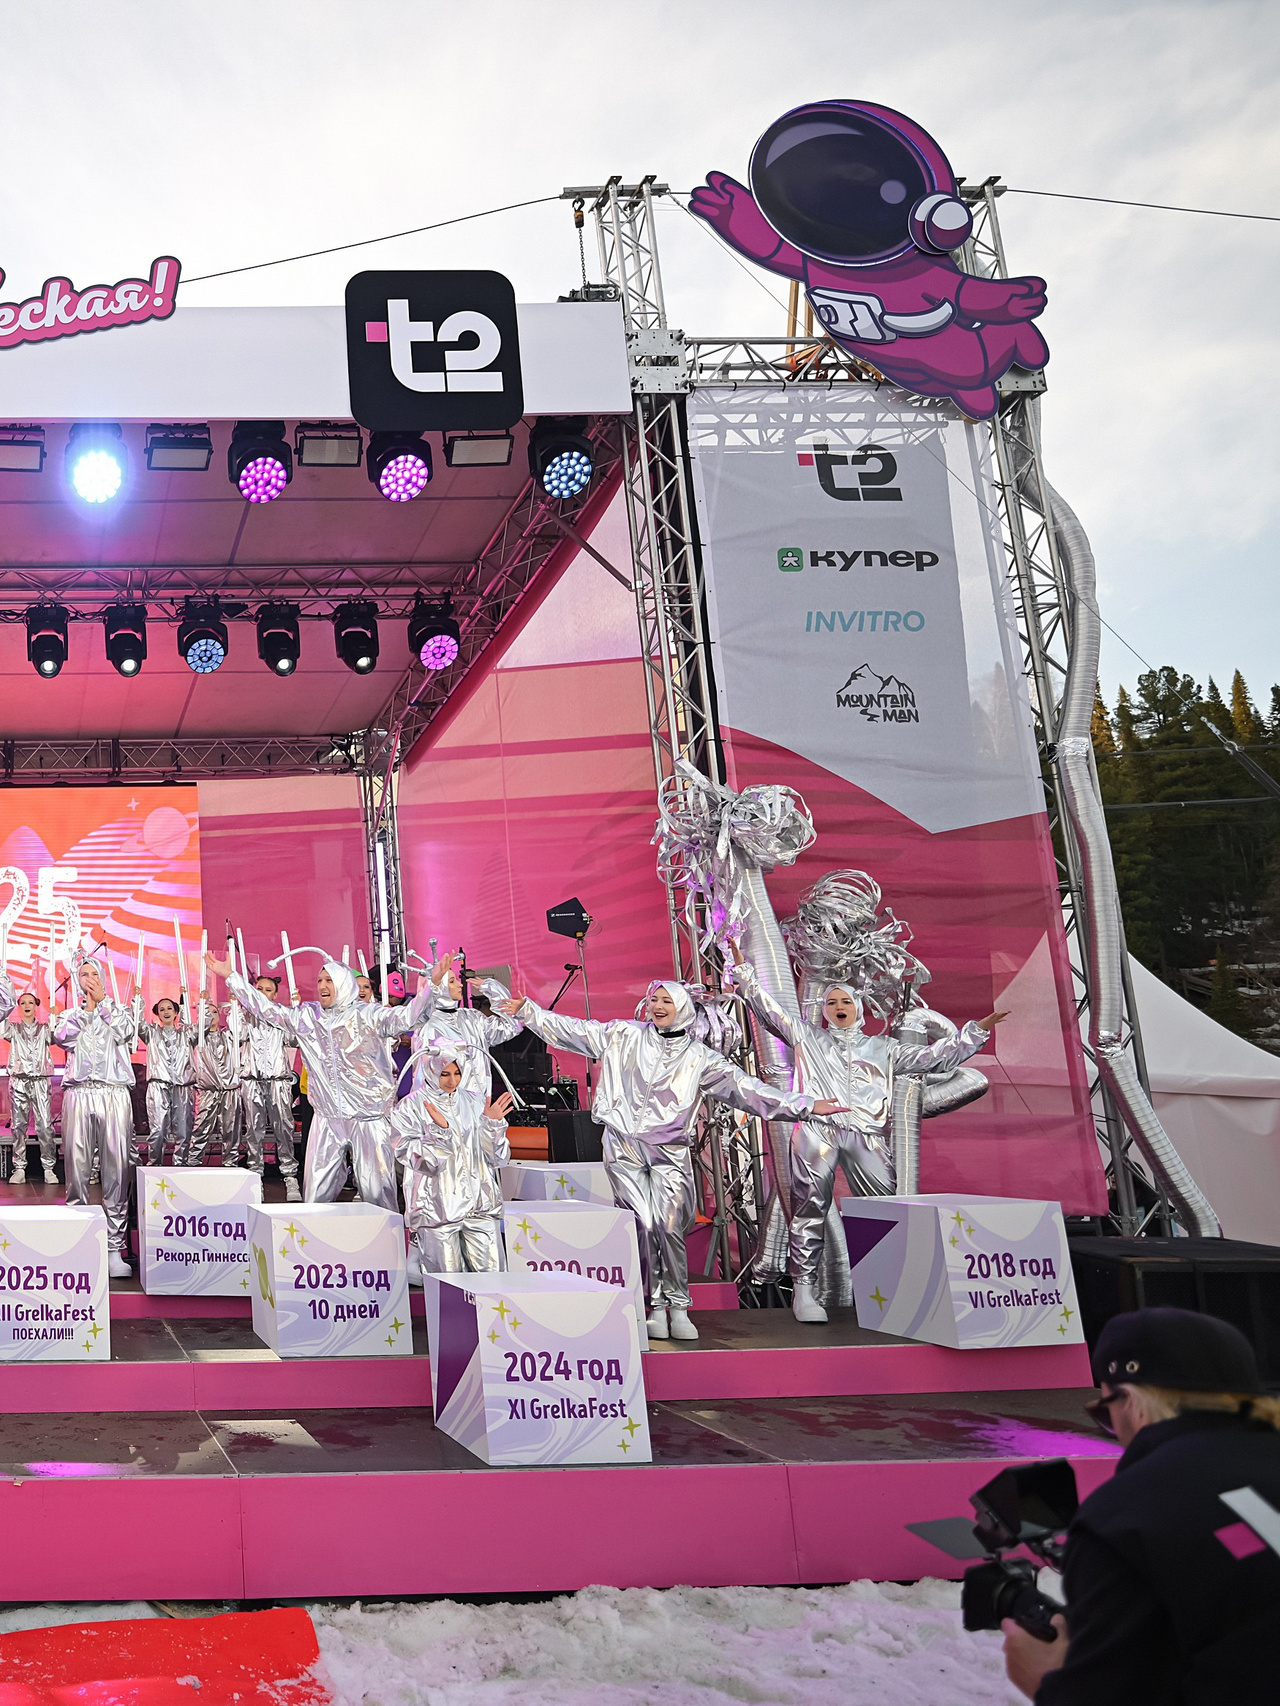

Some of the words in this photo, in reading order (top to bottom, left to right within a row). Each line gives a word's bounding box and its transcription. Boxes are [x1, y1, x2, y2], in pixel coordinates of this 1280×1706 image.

[365, 299, 504, 392] t2
[797, 437, 903, 502] t2
[805, 610, 926, 633] INVITRO
[882, 708, 920, 723] MAN
[163, 1215, 210, 1238] 2016
[213, 1220, 247, 1241] год
[156, 1248, 200, 1266] Рекорд
[202, 1248, 251, 1263] Гиннесс
[964, 1252, 1016, 1279] 2018
[1019, 1257, 1056, 1280] год
[53, 1272, 91, 1294] год
[293, 1264, 349, 1290] 2023
[352, 1268, 392, 1292] год
[308, 1298, 330, 1321] 10
[333, 1298, 381, 1323] дней
[968, 1290, 985, 1309] VI
[986, 1288, 1063, 1308] GrelkaFest
[14, 1303, 96, 1322] GrelkaFest
[12, 1327, 74, 1340] ПОЕХАЛИ!!!
[504, 1351, 572, 1383] 2024
[577, 1357, 624, 1385] год
[508, 1398, 526, 1420] XI
[530, 1396, 628, 1420] GrelkaFest
